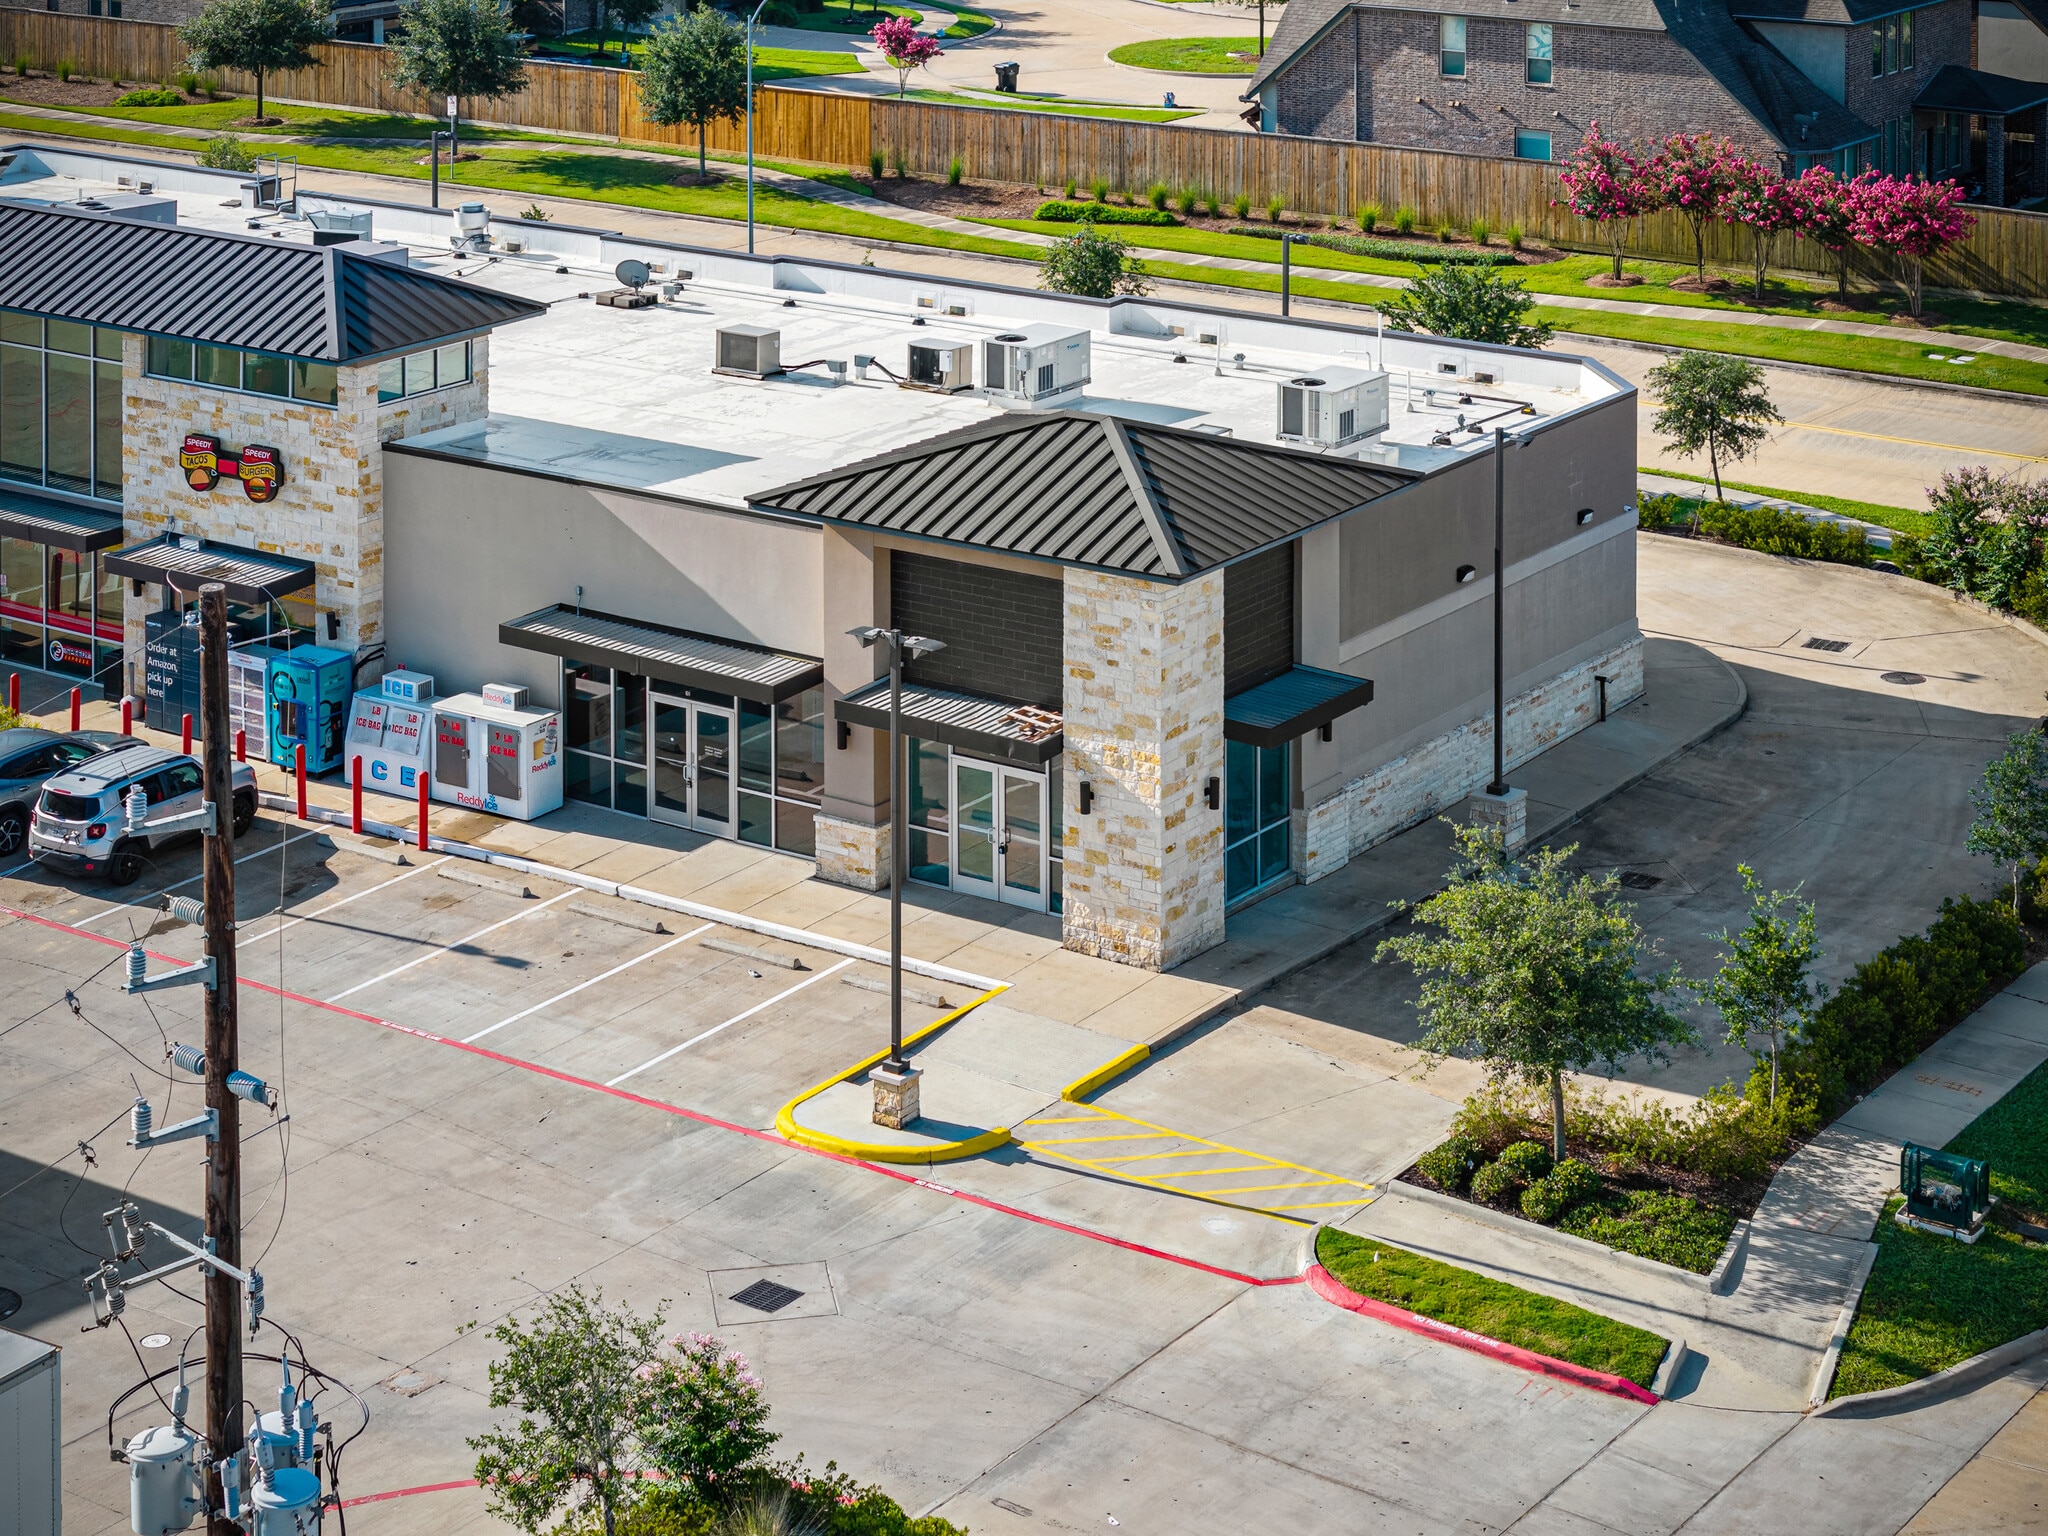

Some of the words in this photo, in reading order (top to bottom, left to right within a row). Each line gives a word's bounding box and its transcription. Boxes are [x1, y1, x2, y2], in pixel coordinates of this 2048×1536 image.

[186, 438, 212, 449] SPEEDY
[245, 448, 271, 459] SPEEDY
[185, 455, 208, 466] TACOS
[240, 465, 274, 477] BURGERS
[146, 641, 168, 654] Order
[169, 648, 177, 656] at
[147, 656, 178, 673] Amazon,
[147, 672, 162, 683] pick
[163, 676, 173, 687] up
[147, 685, 164, 698] here
[384, 679, 414, 698] ICE
[371, 706, 382, 716] LB
[355, 717, 366, 728] ICE
[367, 720, 382, 731] BAG
[407, 713, 418, 724] LB
[391, 724, 403, 735] ICE
[404, 727, 418, 738] BAG
[451, 721, 461, 731] LB
[438, 733, 450, 744] ICE
[451, 736, 465, 747] BAG
[503, 734, 513, 744] LB
[489, 745, 501, 755] ICE
[503, 748, 517, 759] BAG
[925, 1182, 956, 1195] PARKING
[1412, 1314, 1426, 1323] NO
[1425, 1318, 1459, 1334] PARKING
[1460, 1329, 1478, 1340] FIRE
[1478, 1337, 1501, 1348] LANE
